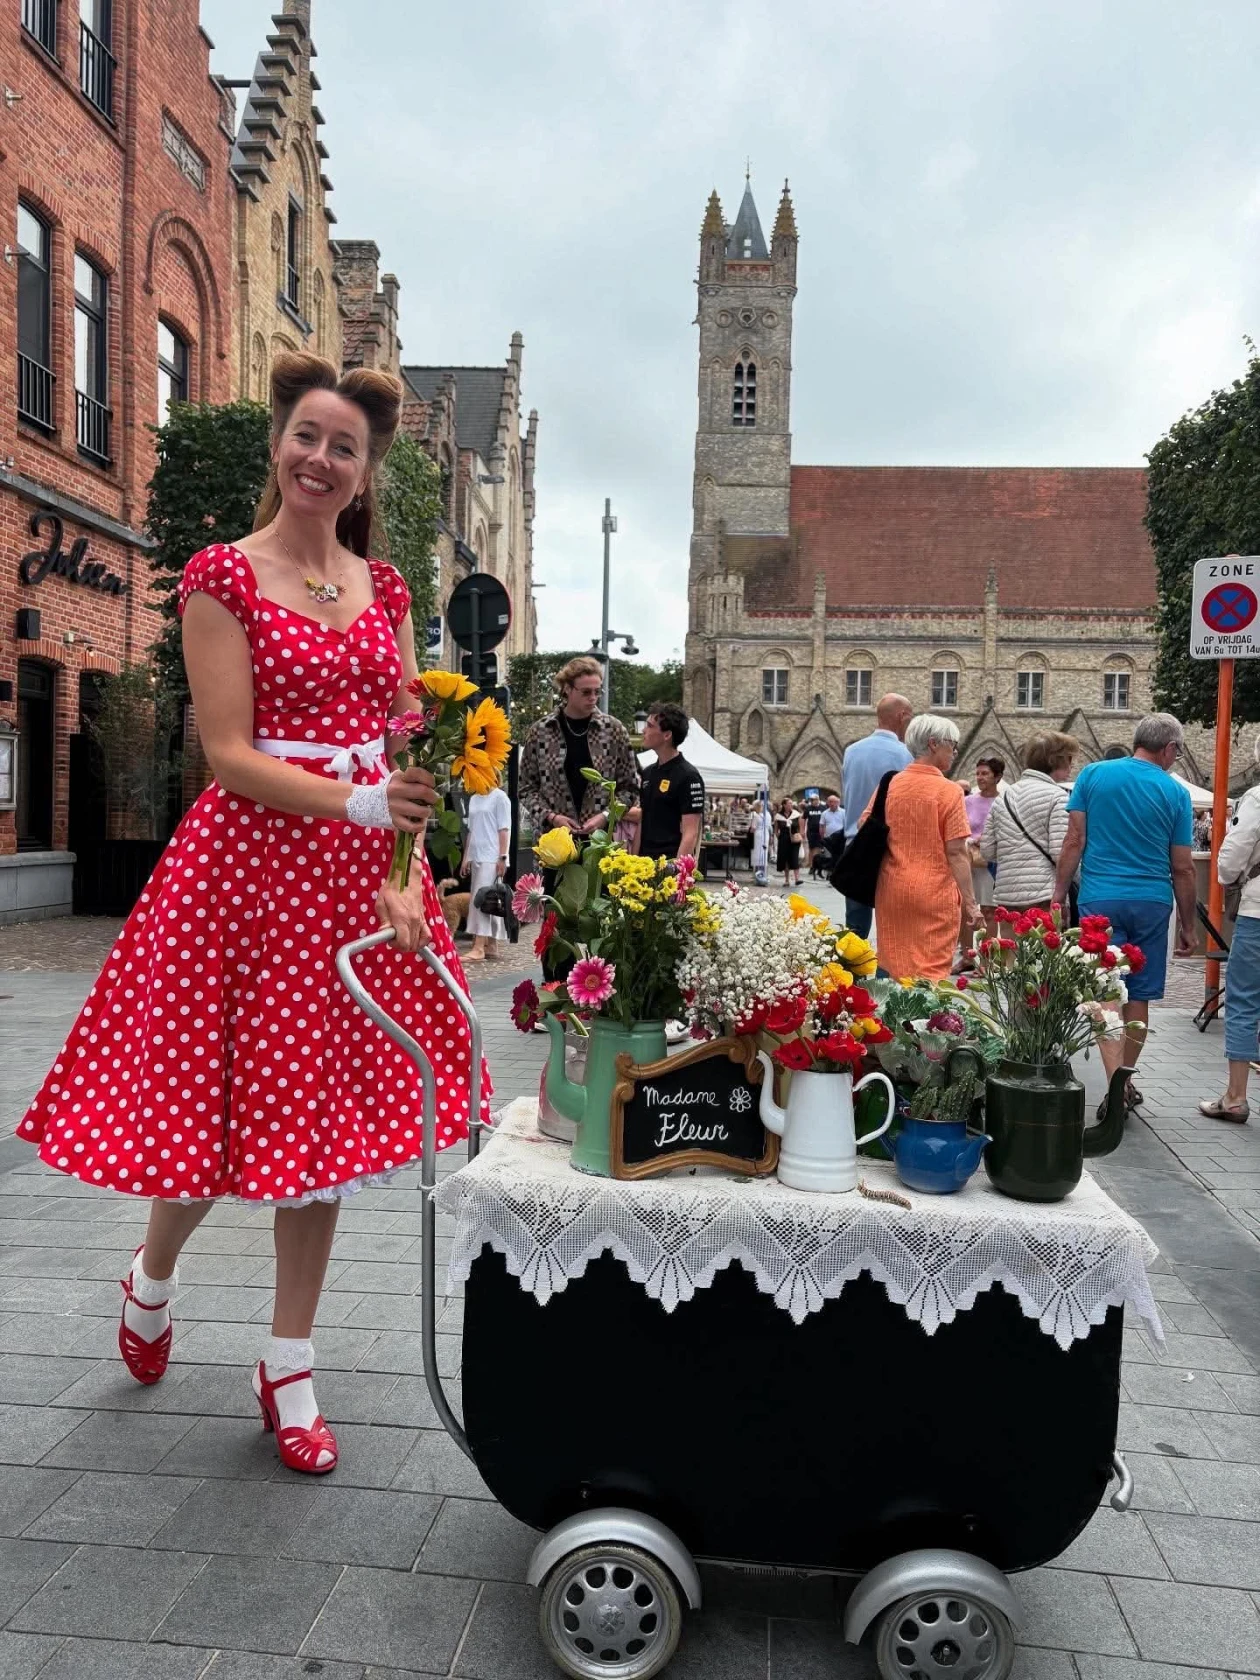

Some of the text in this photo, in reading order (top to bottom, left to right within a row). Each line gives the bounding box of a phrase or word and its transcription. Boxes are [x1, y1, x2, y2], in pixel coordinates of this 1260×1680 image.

[20, 510, 129, 595] Julien
[1209, 564, 1254, 577] ZONE
[1203, 635, 1252, 645] OP VRIJDAG
[1195, 646, 1211, 655] VAN
[1214, 646, 1224, 655] 6u
[1227, 645, 1243, 654] TOT
[643, 1085, 721, 1107] Madame
[654, 1112, 729, 1147] Fleur
